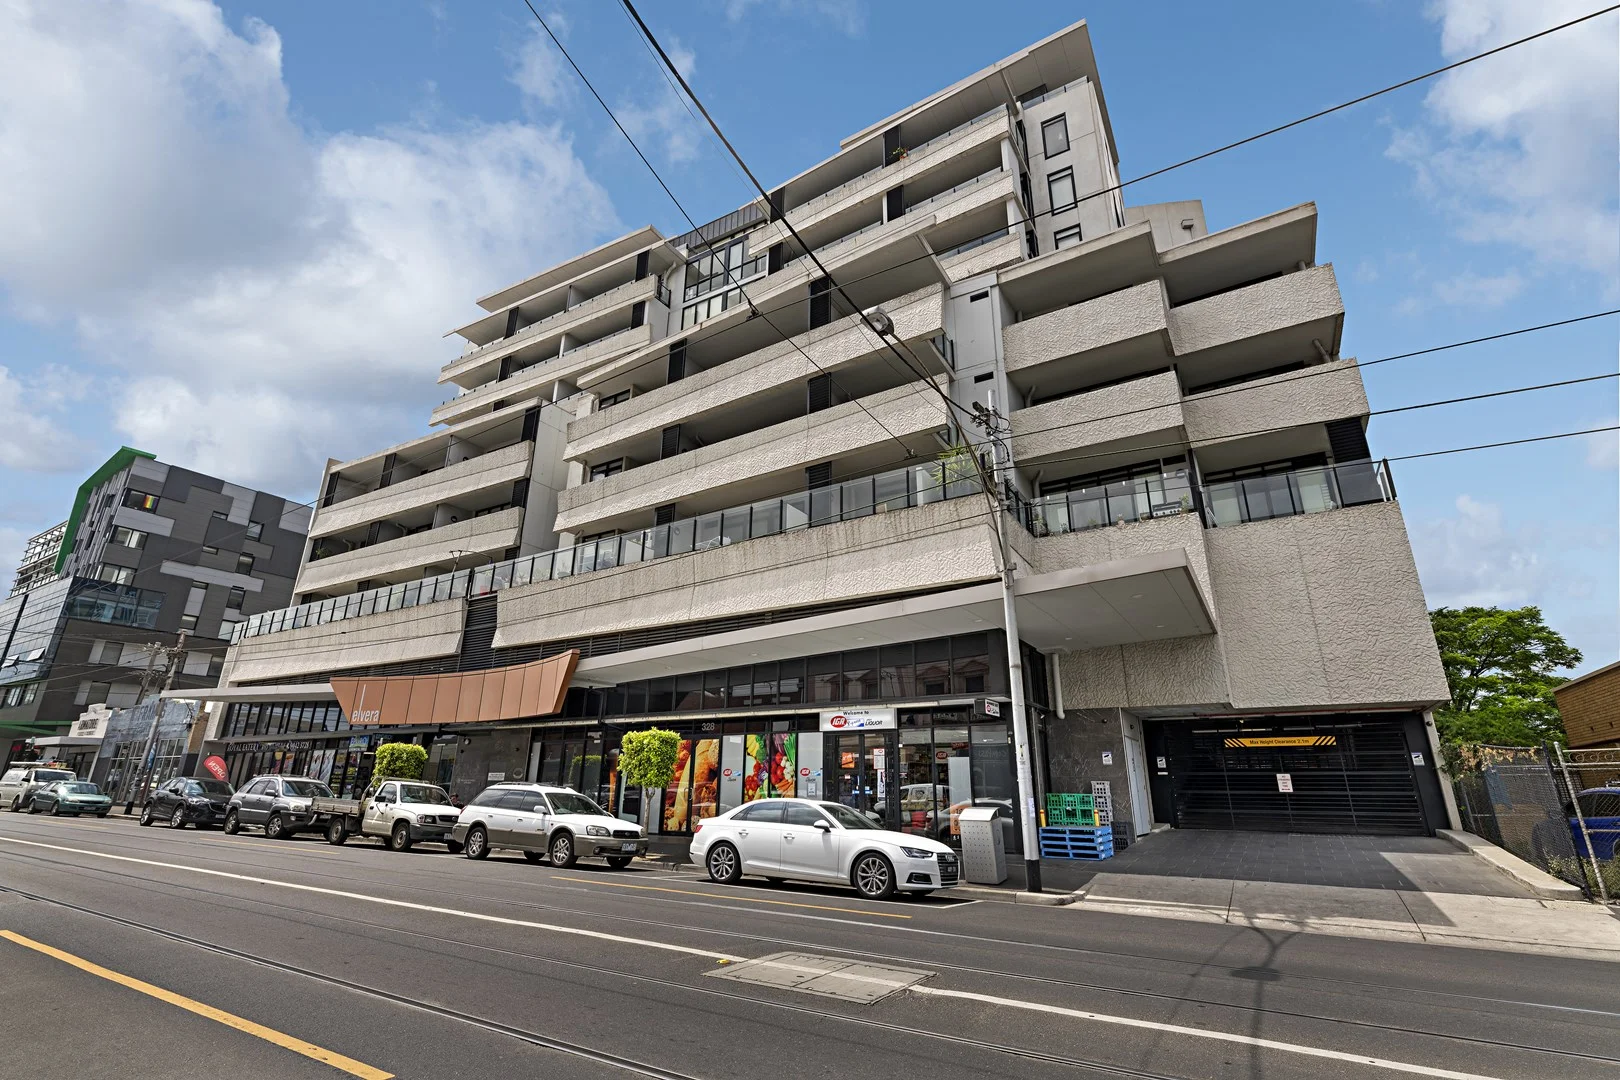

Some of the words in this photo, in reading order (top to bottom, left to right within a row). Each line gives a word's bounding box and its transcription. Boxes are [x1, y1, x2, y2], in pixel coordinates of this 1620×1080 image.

[352, 684, 379, 722] elvera
[832, 717, 845, 726] IGA
[701, 722, 715, 731] 328
[227, 742, 241, 752] ROYAL
